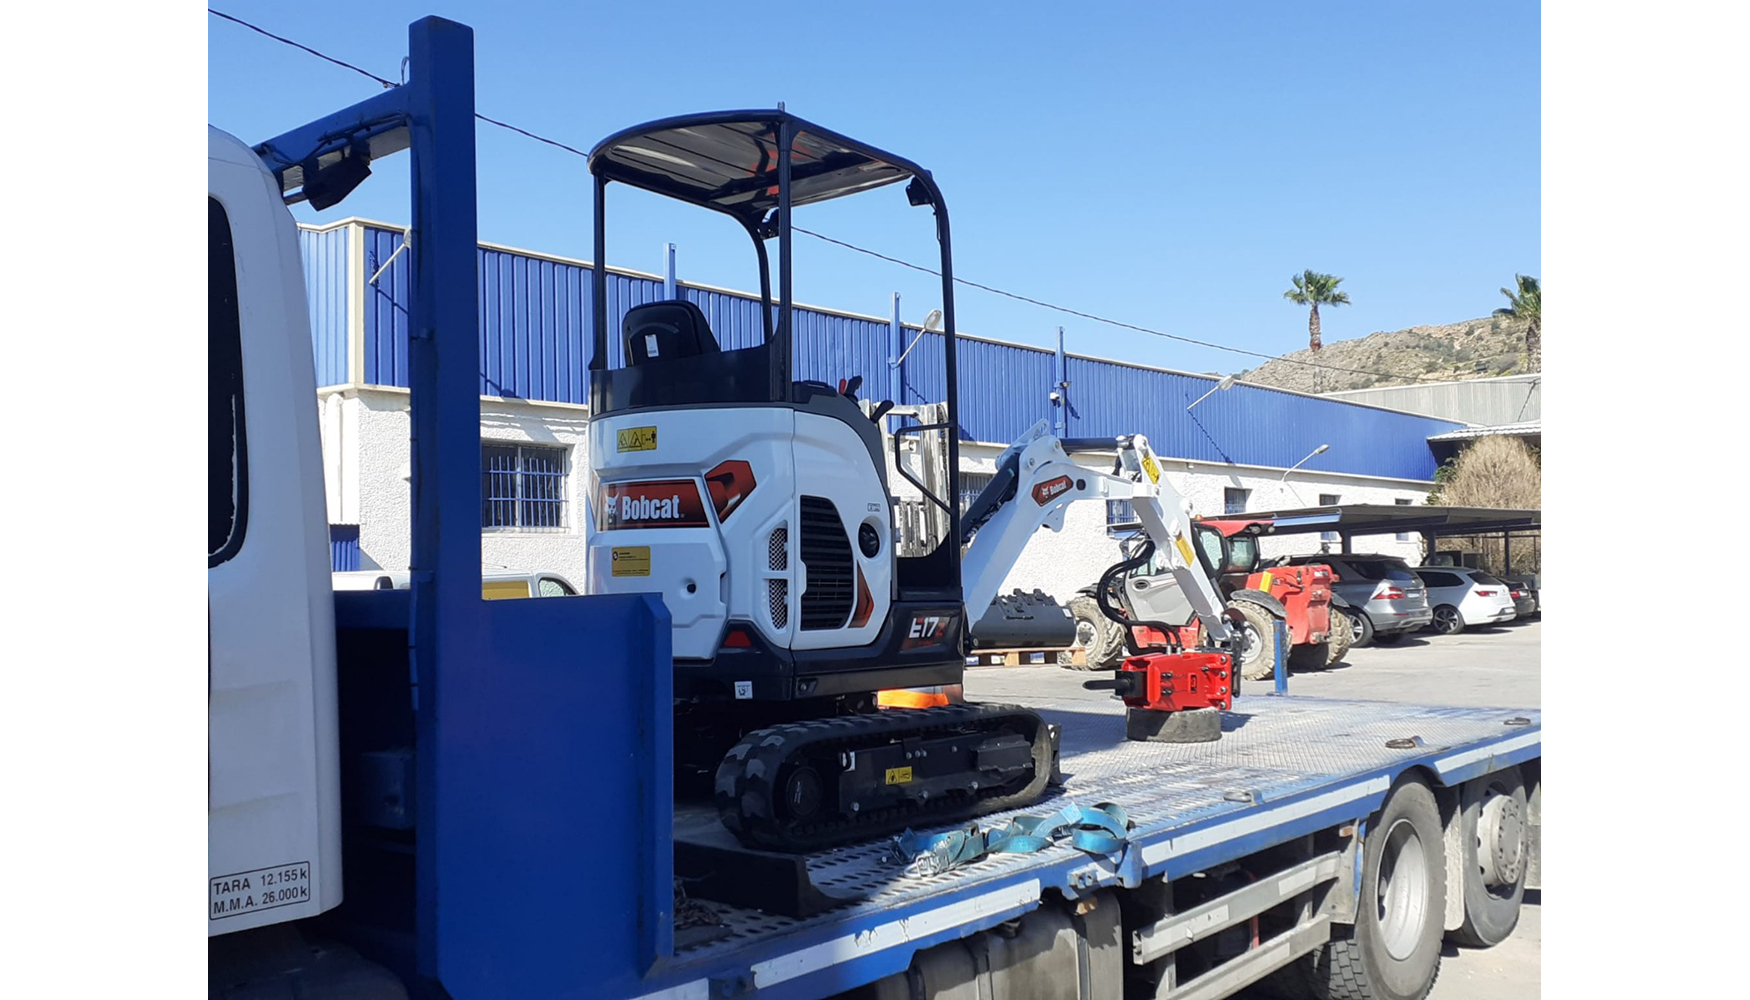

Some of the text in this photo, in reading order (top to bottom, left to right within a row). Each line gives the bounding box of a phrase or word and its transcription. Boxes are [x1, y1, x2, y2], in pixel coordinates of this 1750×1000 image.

[621, 494, 680, 520] Bobcat
[213, 878, 251, 895] TARA
[261, 869, 298, 886] 12.155
[213, 895, 258, 914] M.M.A.
[262, 887, 299, 904] 26.000
